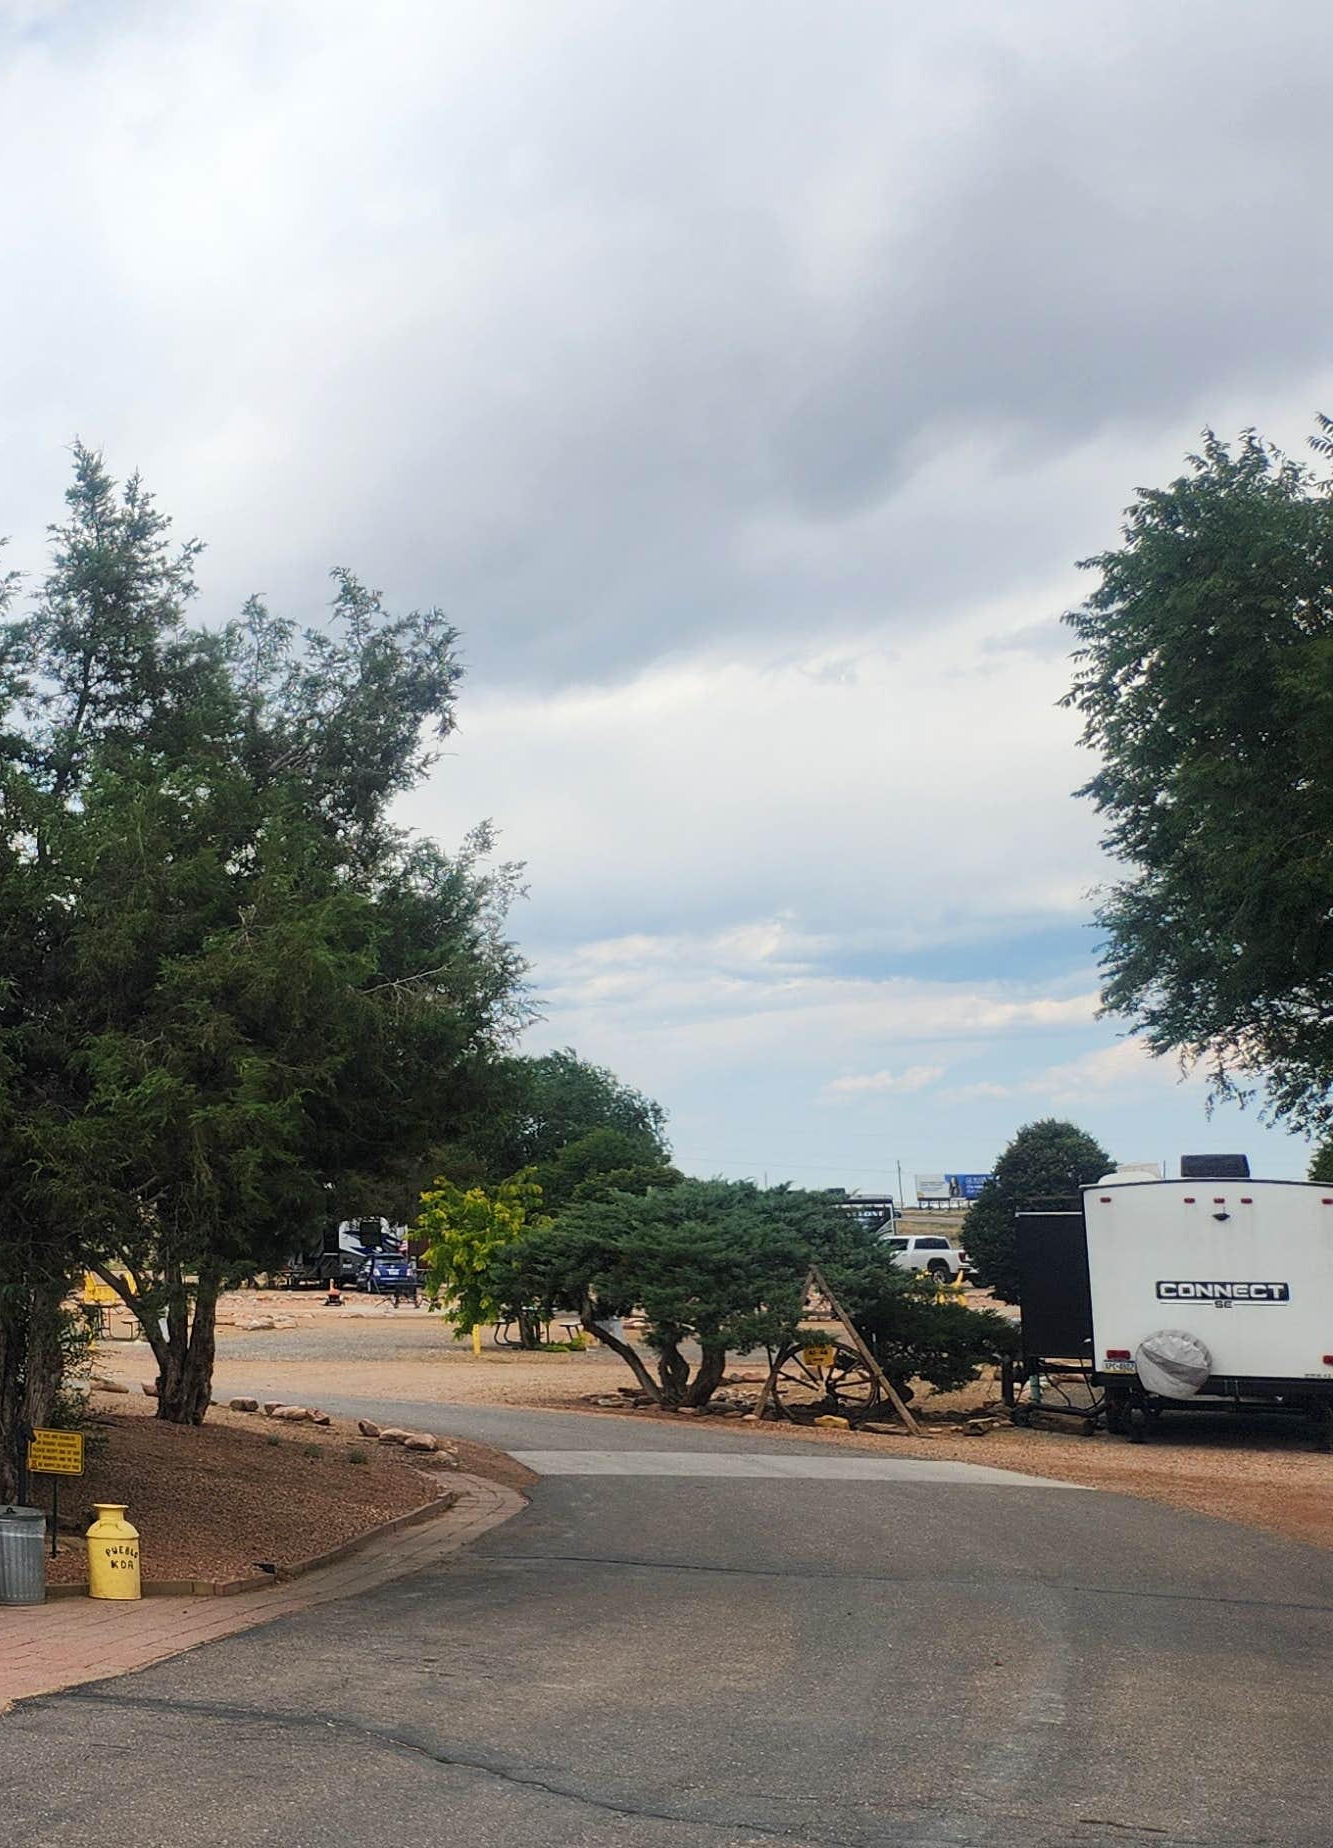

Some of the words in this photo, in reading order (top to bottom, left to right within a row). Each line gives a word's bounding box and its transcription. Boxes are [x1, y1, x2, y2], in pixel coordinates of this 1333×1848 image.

[1159, 1283, 1284, 1299] CONNECT
[1214, 1300, 1233, 1309] SE
[105, 1546, 138, 1558] PUEBLO
[110, 1560, 134, 1570] KOA
